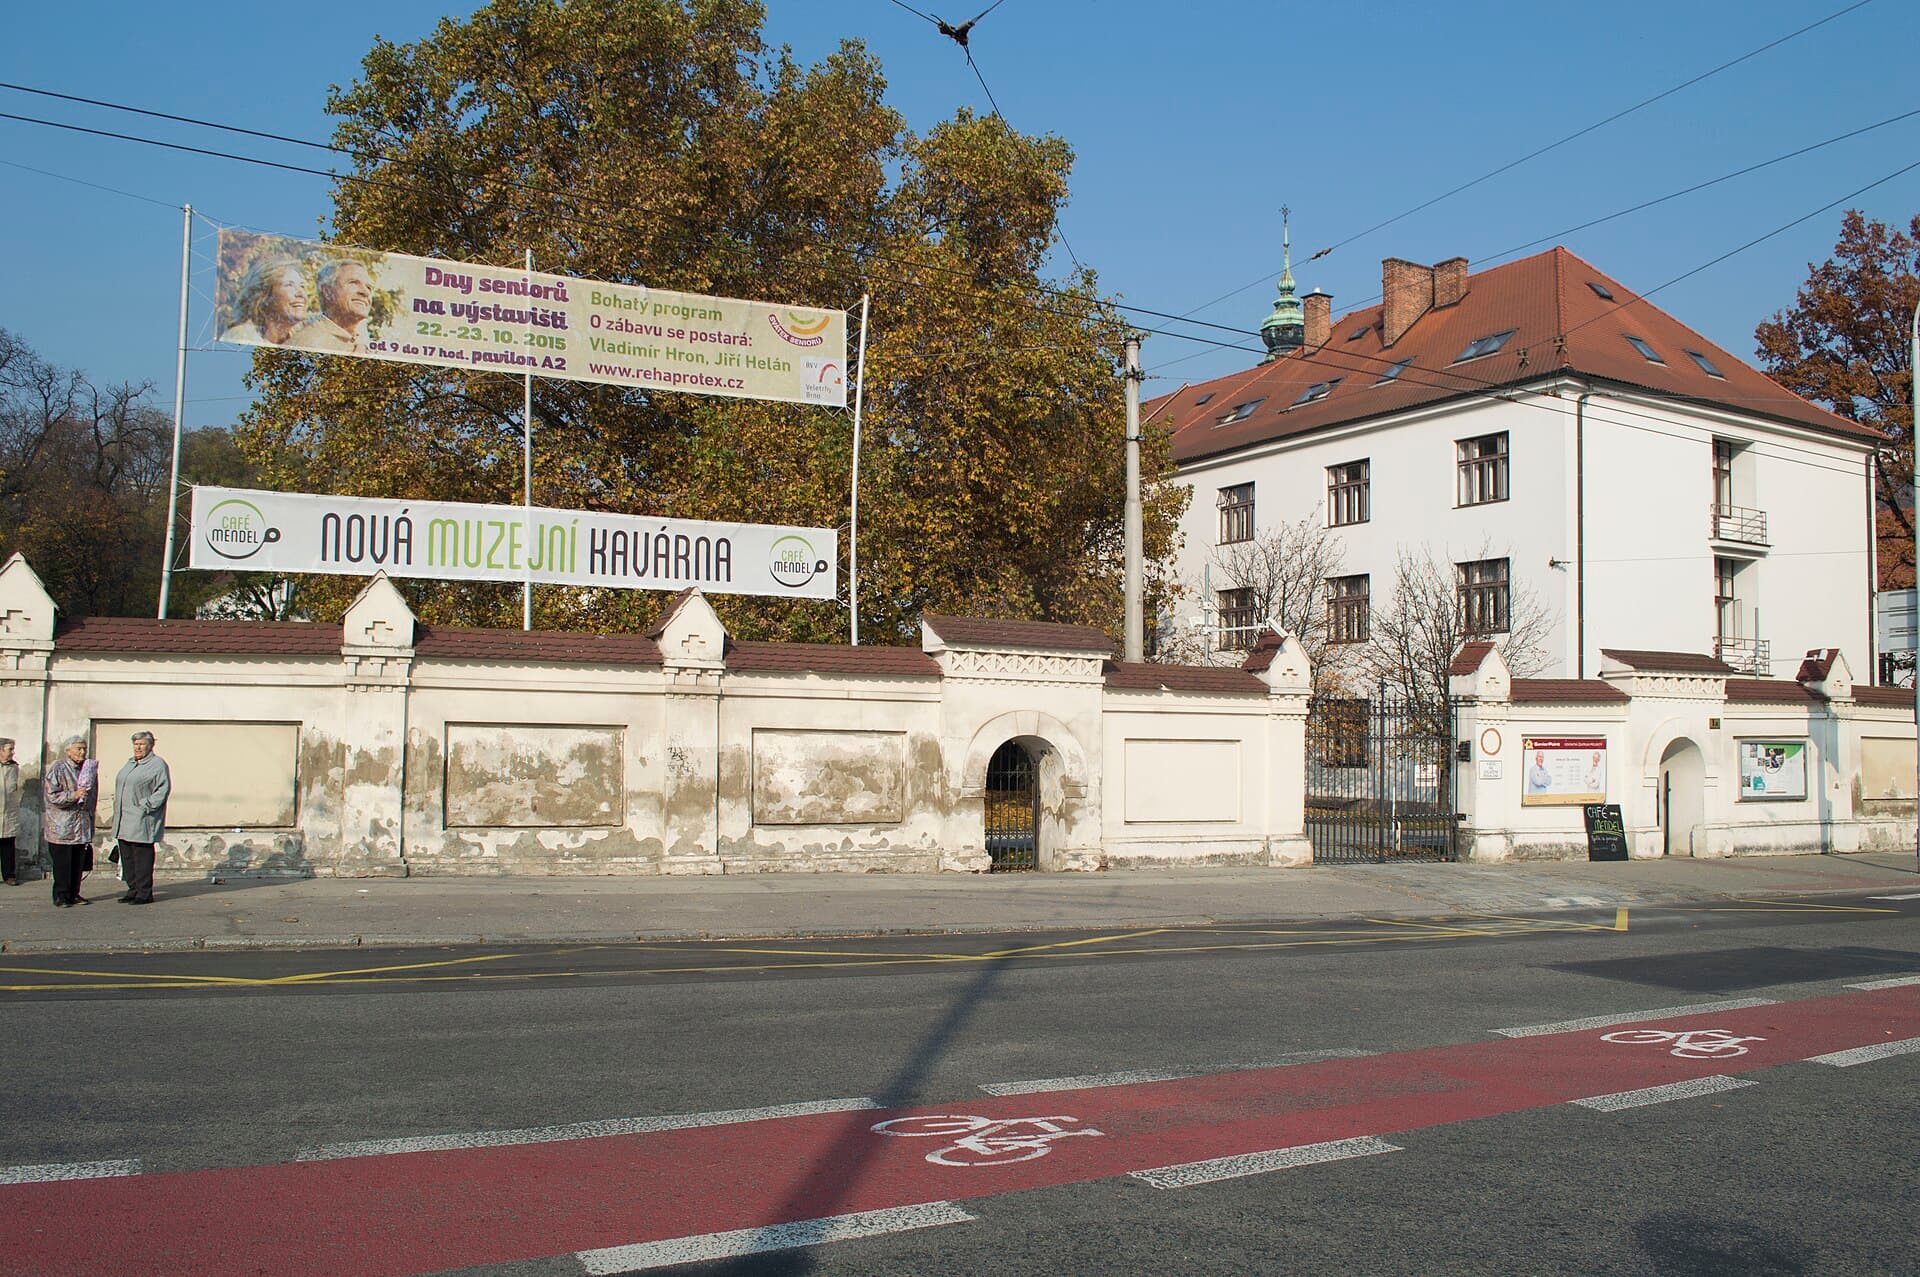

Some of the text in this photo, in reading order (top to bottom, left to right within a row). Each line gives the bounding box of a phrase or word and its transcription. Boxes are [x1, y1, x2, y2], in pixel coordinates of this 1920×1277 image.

[425, 267, 570, 303] Dny seniorů
[413, 298, 569, 330] na výstavišti
[591, 291, 723, 321] Bohatý program
[416, 321, 567, 351] 22.-23. 10. 2015
[606, 317, 662, 337] zábavu
[667, 327, 685, 340] se
[689, 330, 753, 347] postará:
[369, 341, 567, 371] od 9 do 17 hod. pavilon A2
[589, 336, 791, 373] Vladimír Hron, Jiří Helán
[589, 362, 745, 390] www.rehaprotex.cz
[805, 392, 821, 400] Brno
[212, 529, 258, 543] MENDEL
[222, 514, 249, 530] CAFÉ
[321, 508, 732, 582] NOVÁ MUZEJNÍ KAVÁRNA
[781, 548, 804, 562] CAFÉ
[774, 561, 810, 573] MENDEL
